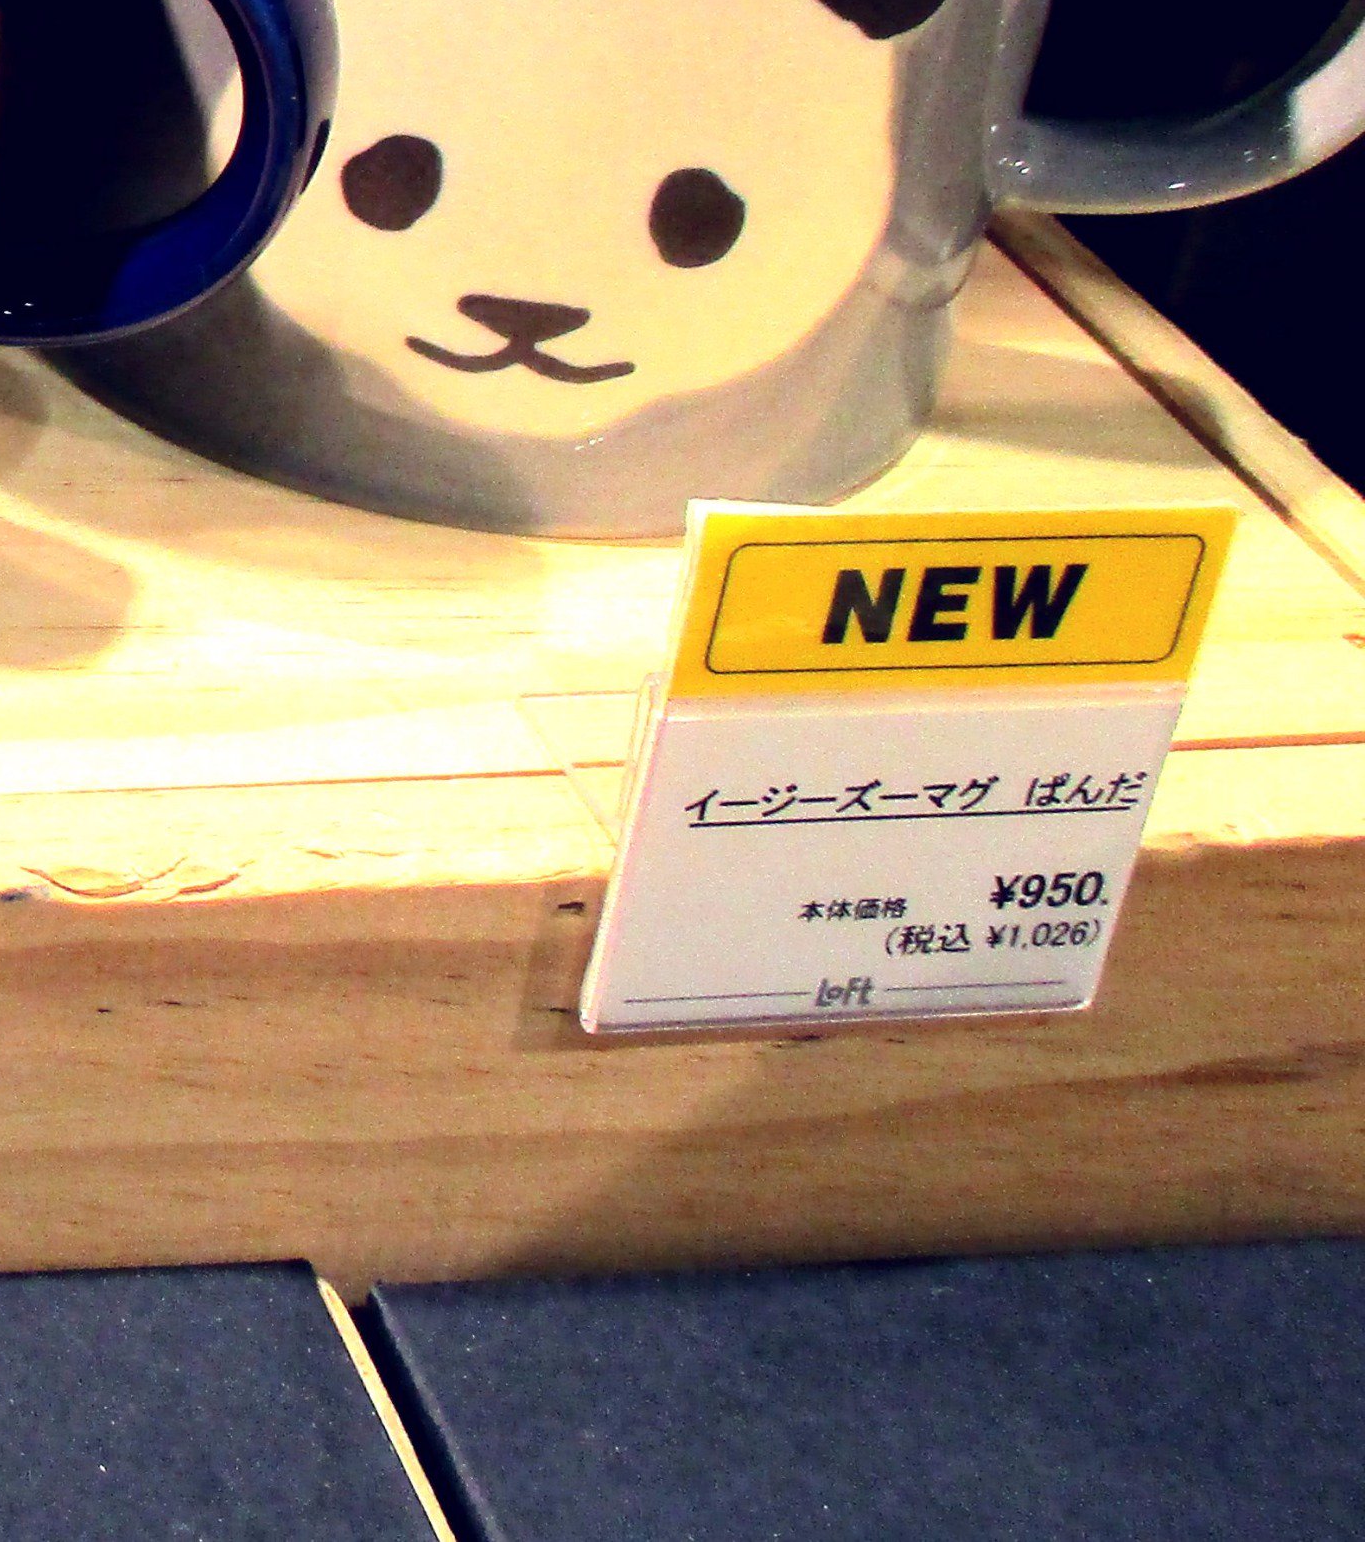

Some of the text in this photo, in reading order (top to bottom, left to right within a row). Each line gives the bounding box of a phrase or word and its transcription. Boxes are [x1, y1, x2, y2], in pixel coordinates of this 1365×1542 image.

[822, 564, 1090, 645] NEW
[684, 771, 1149, 822] イージーズーマグ ぱんだ
[798, 898, 908, 922] 本体価格
